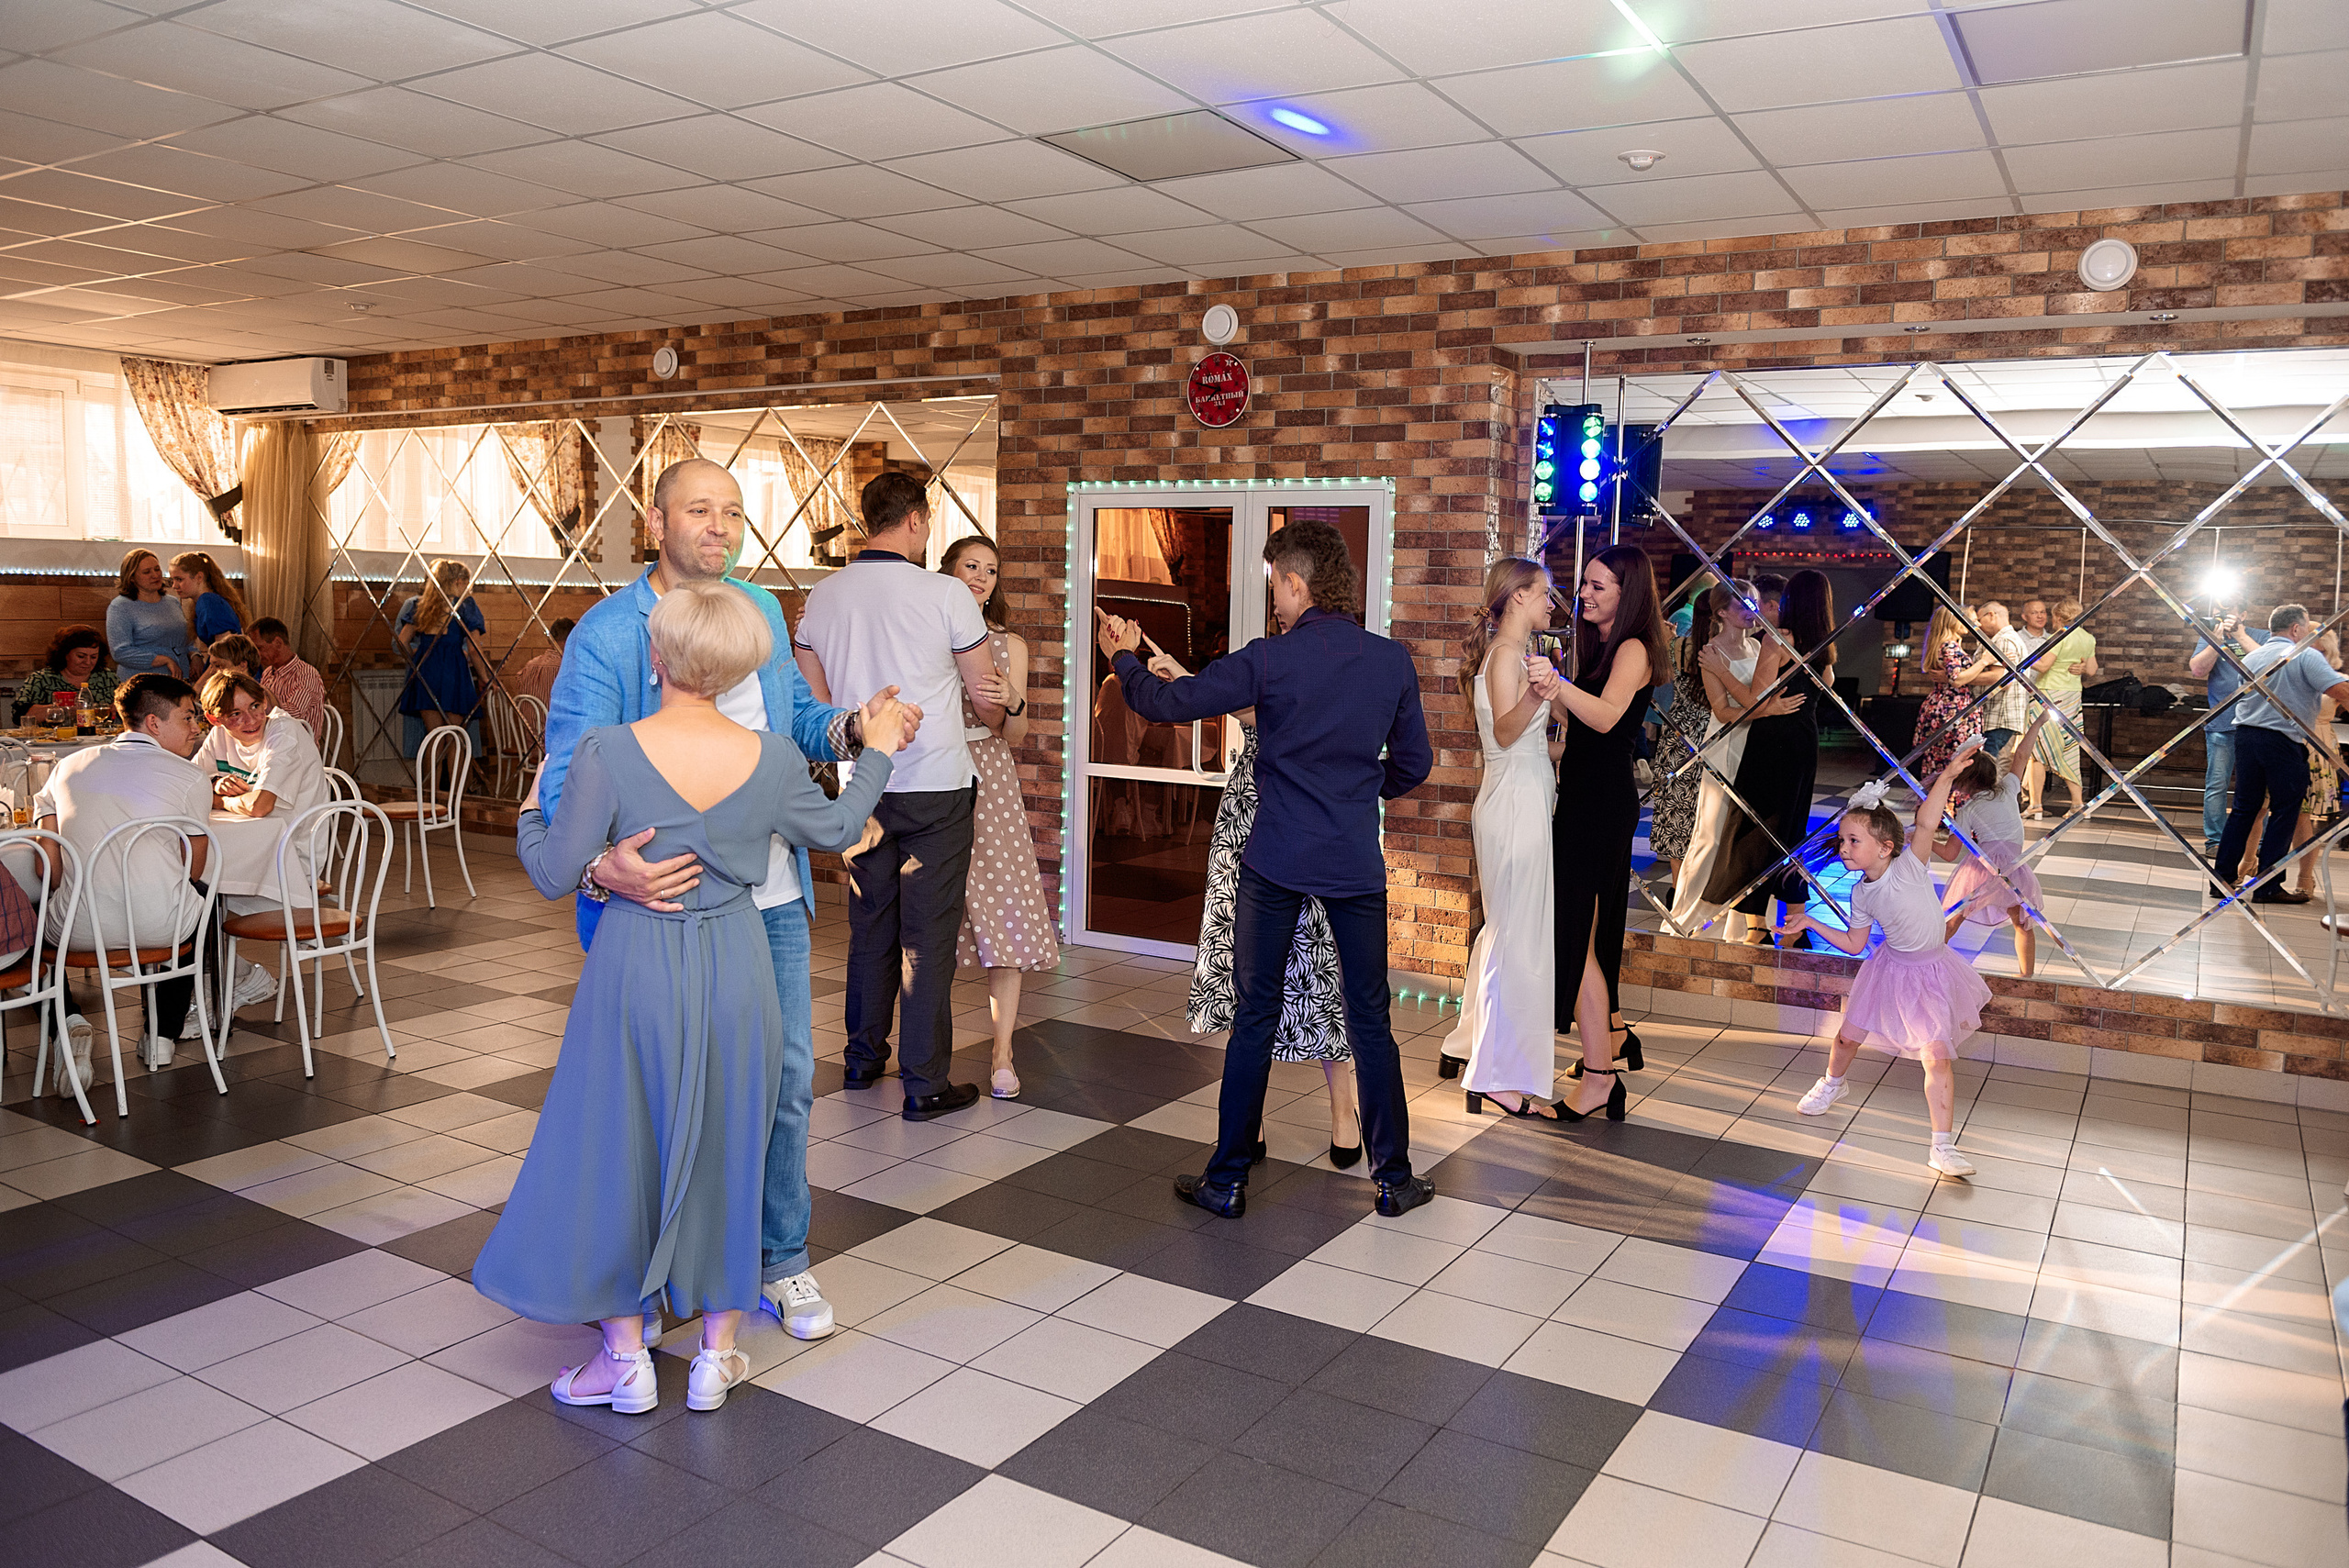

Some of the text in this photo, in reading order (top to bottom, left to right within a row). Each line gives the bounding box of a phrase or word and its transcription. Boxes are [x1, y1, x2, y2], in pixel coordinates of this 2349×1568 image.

[1213, 355, 1220, 363] 12
[1241, 382, 1246, 390] 3
[1191, 388, 1196, 396] 9
[1196, 391, 1244, 404] БАНКЕТНЫЙ
[1204, 412, 1209, 421] 7
[1230, 409, 1235, 417] 5
[1218, 416, 1222, 424] 6
